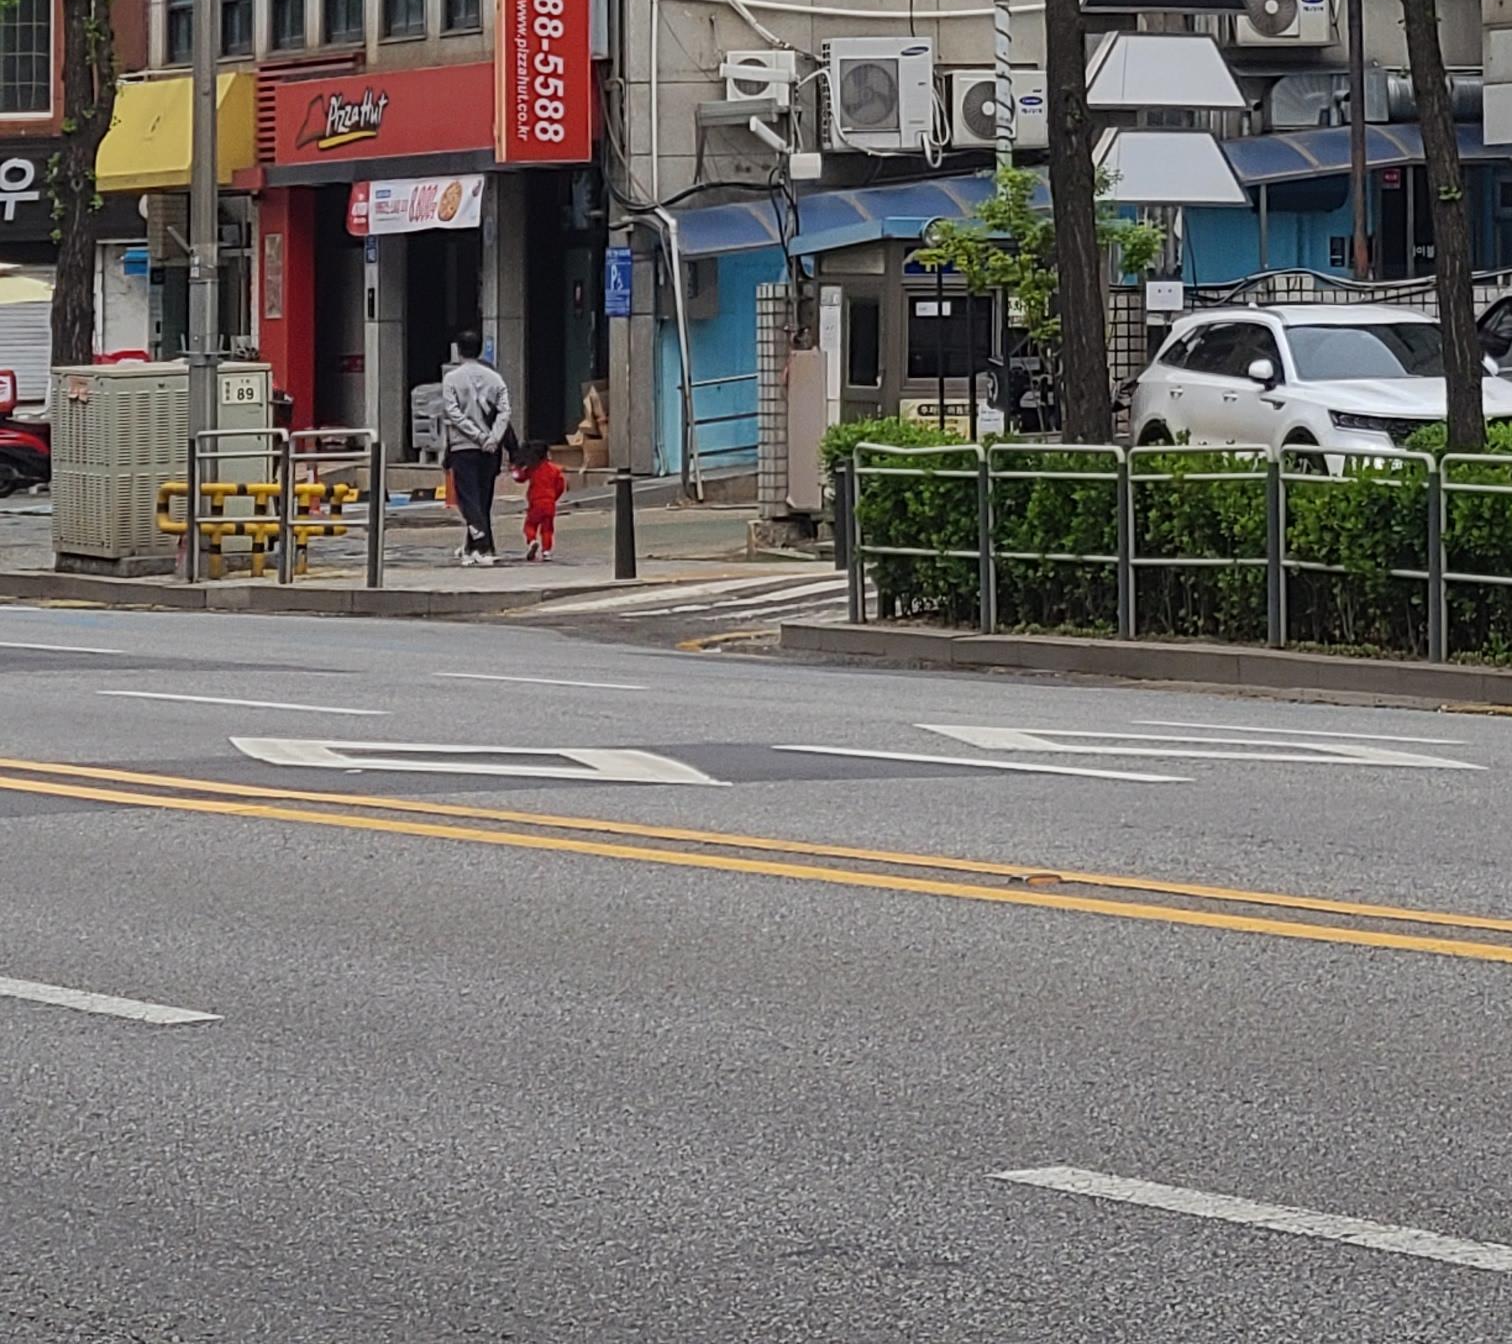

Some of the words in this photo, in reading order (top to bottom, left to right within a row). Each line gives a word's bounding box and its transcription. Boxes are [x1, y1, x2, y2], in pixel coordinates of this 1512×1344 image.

[514, 0, 531, 142] www.pizzahut.co.kr
[325, 94, 359, 138] Pizza
[359, 87, 389, 127] Hut
[236, 387, 255, 401] 89
